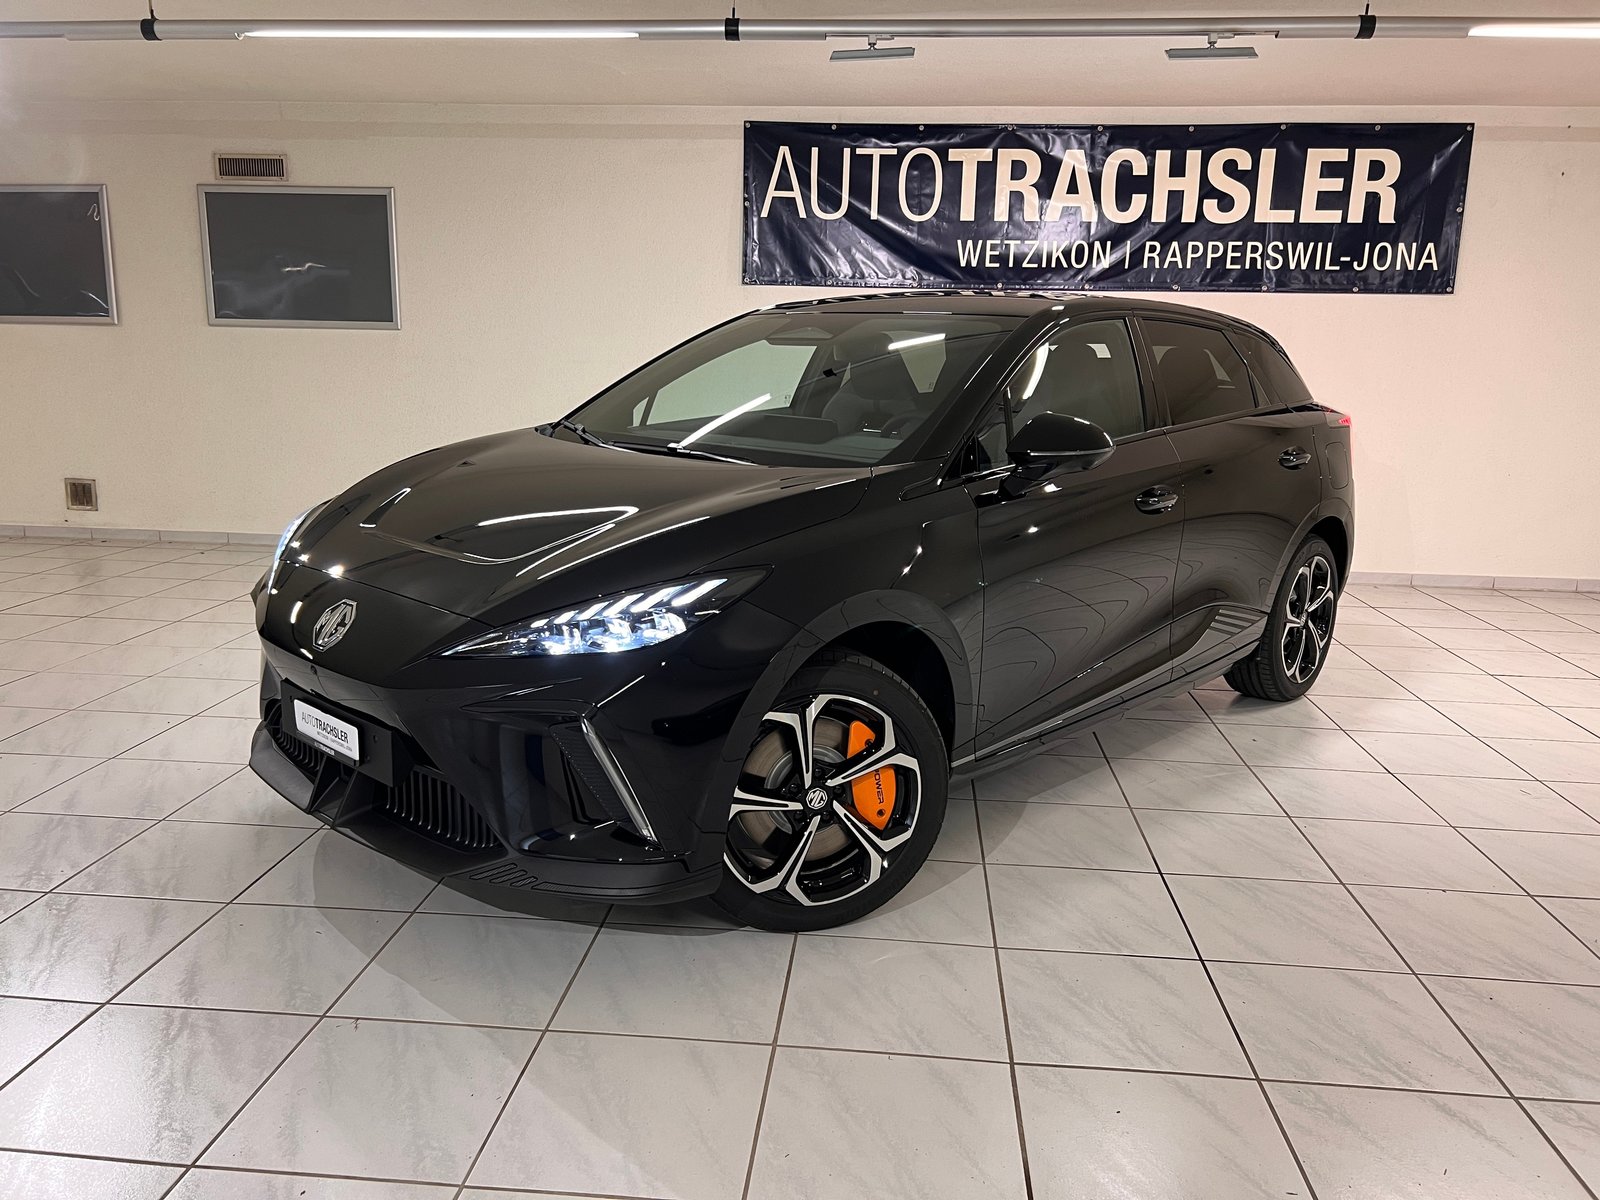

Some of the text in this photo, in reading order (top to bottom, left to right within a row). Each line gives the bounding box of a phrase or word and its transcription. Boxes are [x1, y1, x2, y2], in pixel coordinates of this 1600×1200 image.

[760, 145, 1401, 225] AUTOTRACHSLER
[956, 239, 1112, 269] WETZIKON
[1142, 241, 1439, 272] RAPPERSWIL-JONA
[315, 602, 354, 648] MG
[301, 711, 349, 744] AUTOTRACHSLER
[807, 789, 826, 808] MG
